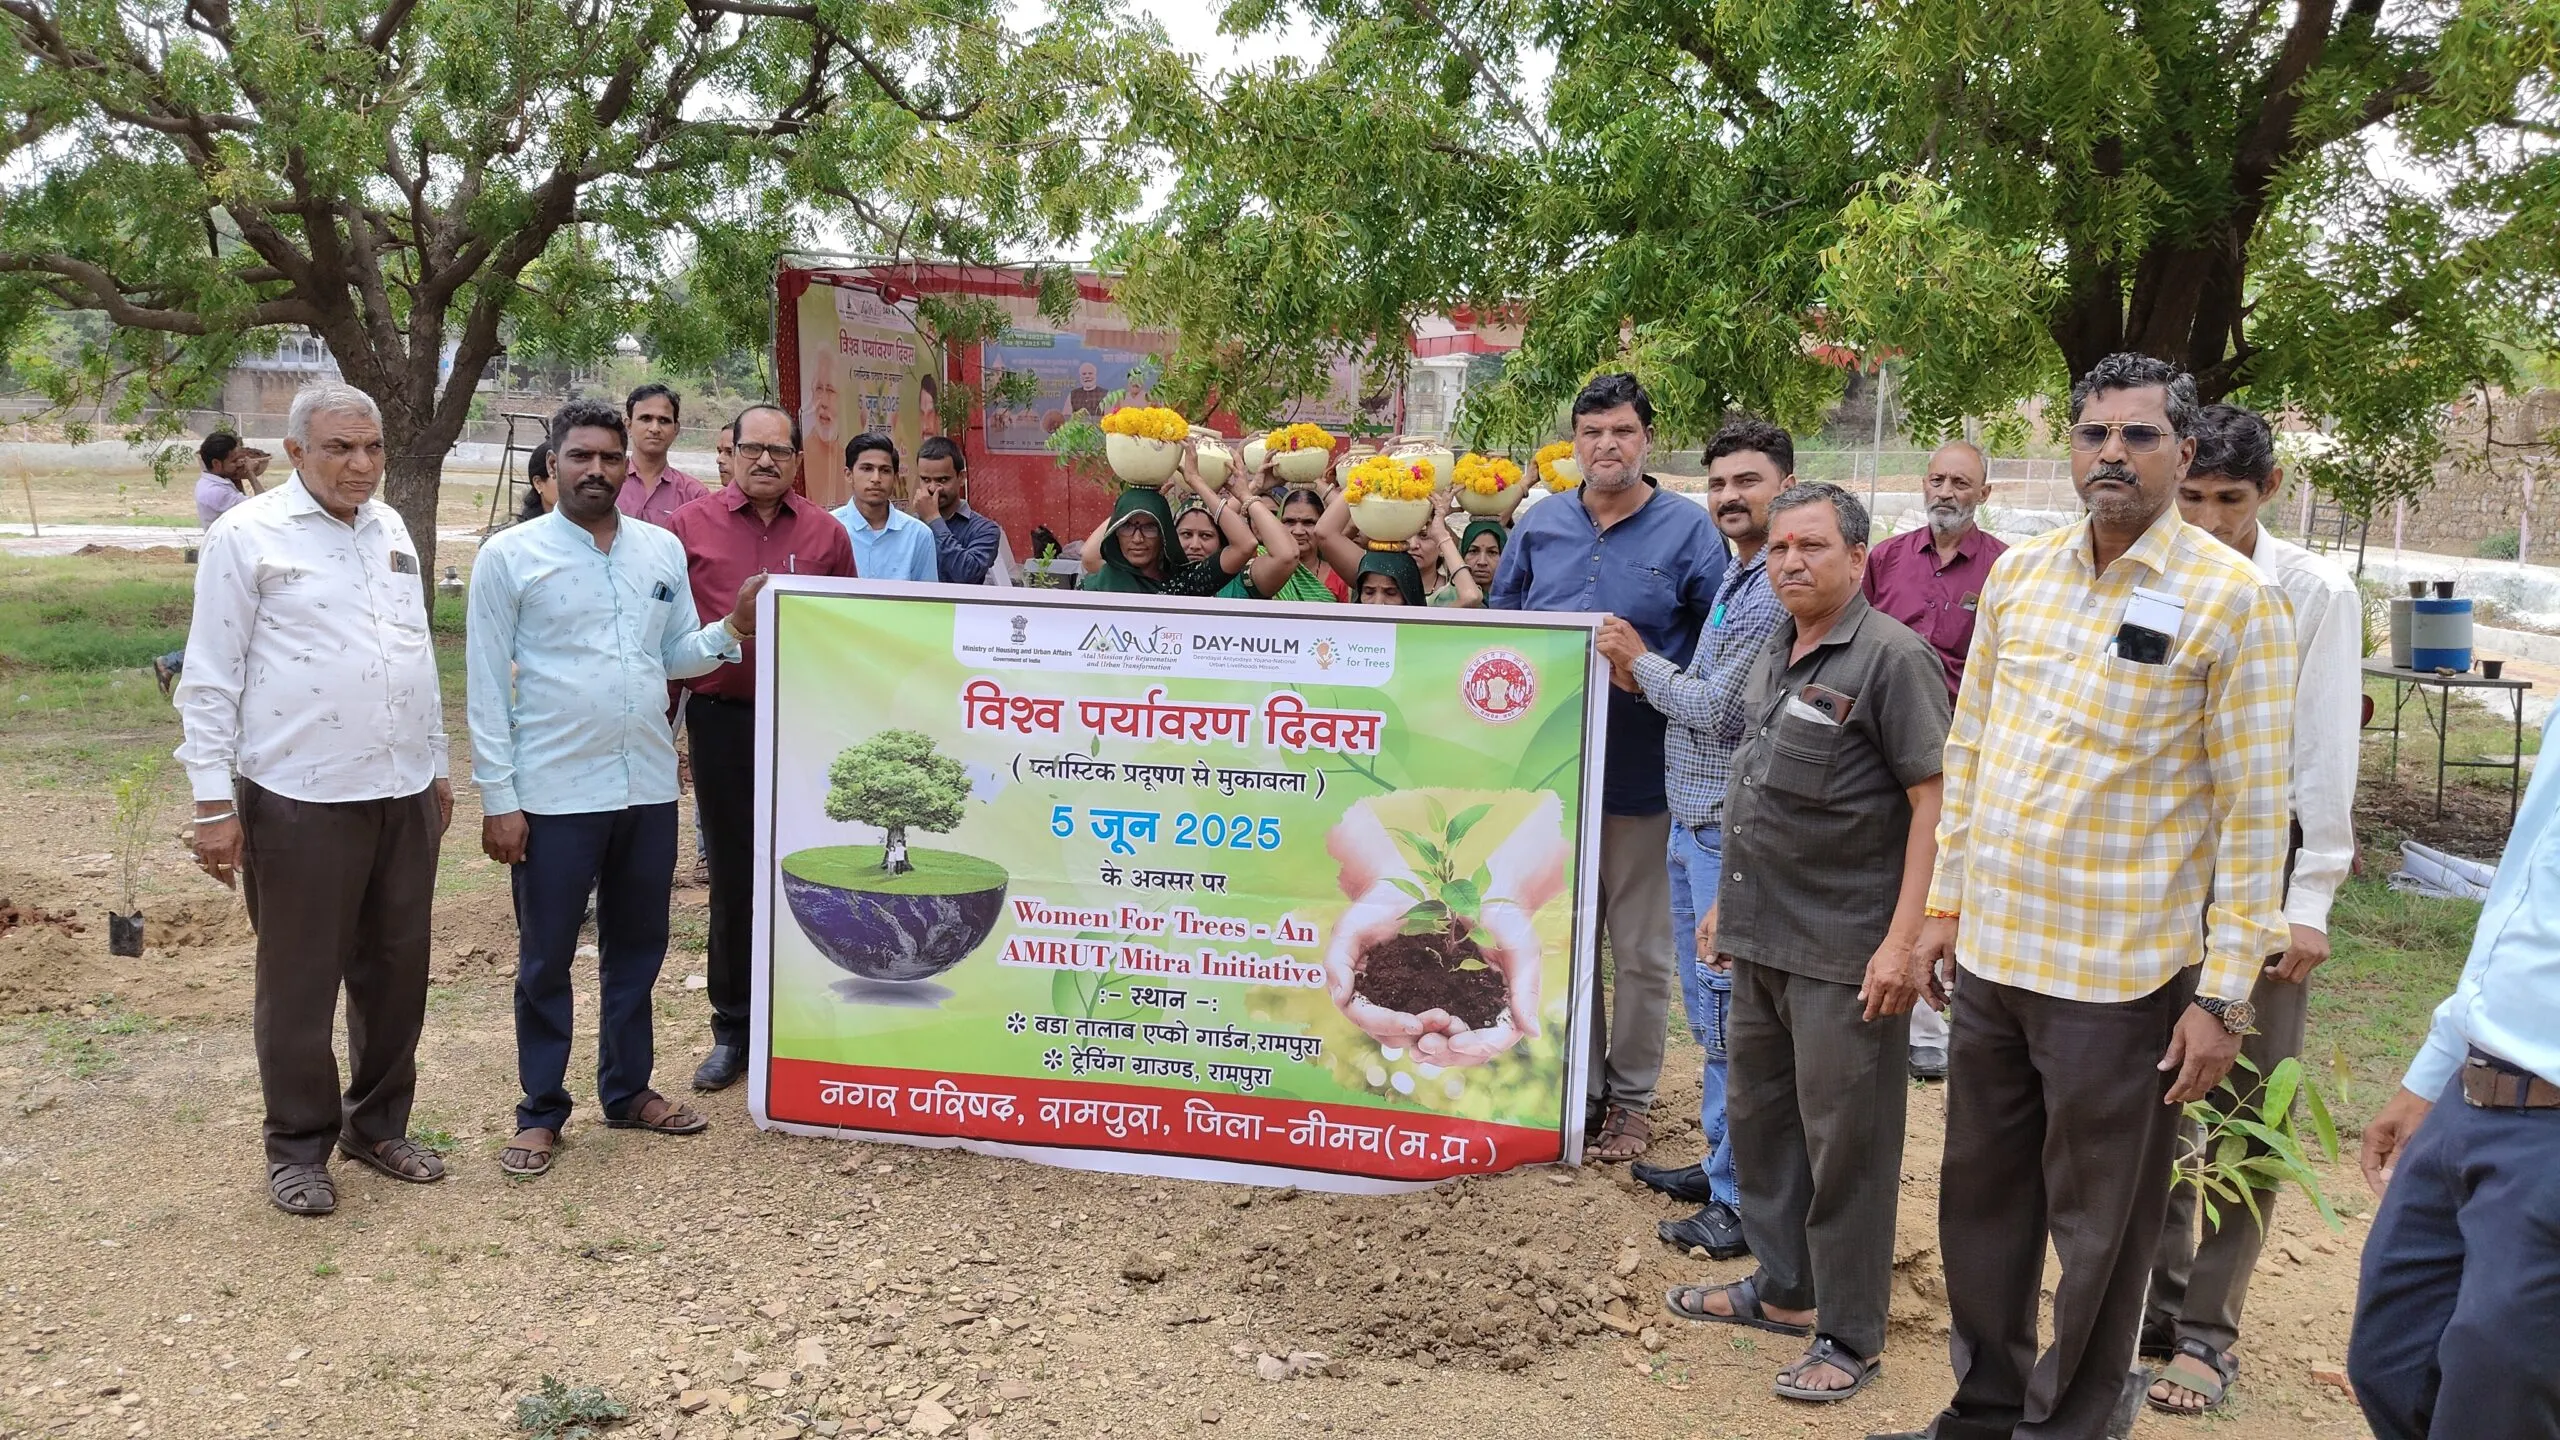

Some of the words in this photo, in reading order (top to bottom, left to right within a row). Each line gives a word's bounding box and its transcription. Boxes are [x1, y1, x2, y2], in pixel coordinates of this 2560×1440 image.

[962, 645, 986, 653] Ministry
[996, 646, 1020, 655] Housing
[1053, 649, 1073, 657] Affairs
[1123, 653, 1134, 661] for
[1161, 643, 1182, 655] 2.0
[1192, 634, 1299, 654] DAY-NULM
[1347, 643, 1386, 654] Women
[1122, 662, 1171, 670] Transformation
[1346, 657, 1360, 667] for
[1364, 658, 1390, 669] Trees
[963, 681, 1064, 733] विश्व
[1078, 689, 1250, 743] पर्यावरण
[1265, 695, 1381, 749] दिवस
[1122, 763, 1185, 792] प्रदूषण
[1192, 760, 1214, 788] से
[1217, 769, 1307, 796] मुकाबला
[1051, 805, 1074, 838] 5
[1090, 808, 1160, 855] जून
[1175, 812, 1282, 850] 2025
[1100, 860, 1122, 887] के
[1130, 869, 1194, 892] अवसर
[1201, 873, 1227, 894] पर
[1013, 900, 1109, 928] Women
[1120, 907, 1164, 932] For
[1174, 911, 1246, 936] Trees
[1276, 918, 1314, 942] An
[1002, 940, 1110, 968] AMRUT
[1119, 948, 1191, 974] Mitra
[1201, 953, 1322, 983] Initiative
[1130, 986, 1187, 1010] स्थान
[1075, 1019, 1136, 1040] तालाब
[1142, 1020, 1189, 1045] एप्को
[1070, 1045, 1126, 1075] ट्रेचिंग
[1132, 1056, 1201, 1083] ग्राउण्ड,
[1208, 1063, 1272, 1090] रामपुरा
[819, 1079, 899, 1117] नगर
[908, 1079, 1025, 1126] परिषद,
[1038, 1097, 1171, 1138] रामपुरा,
